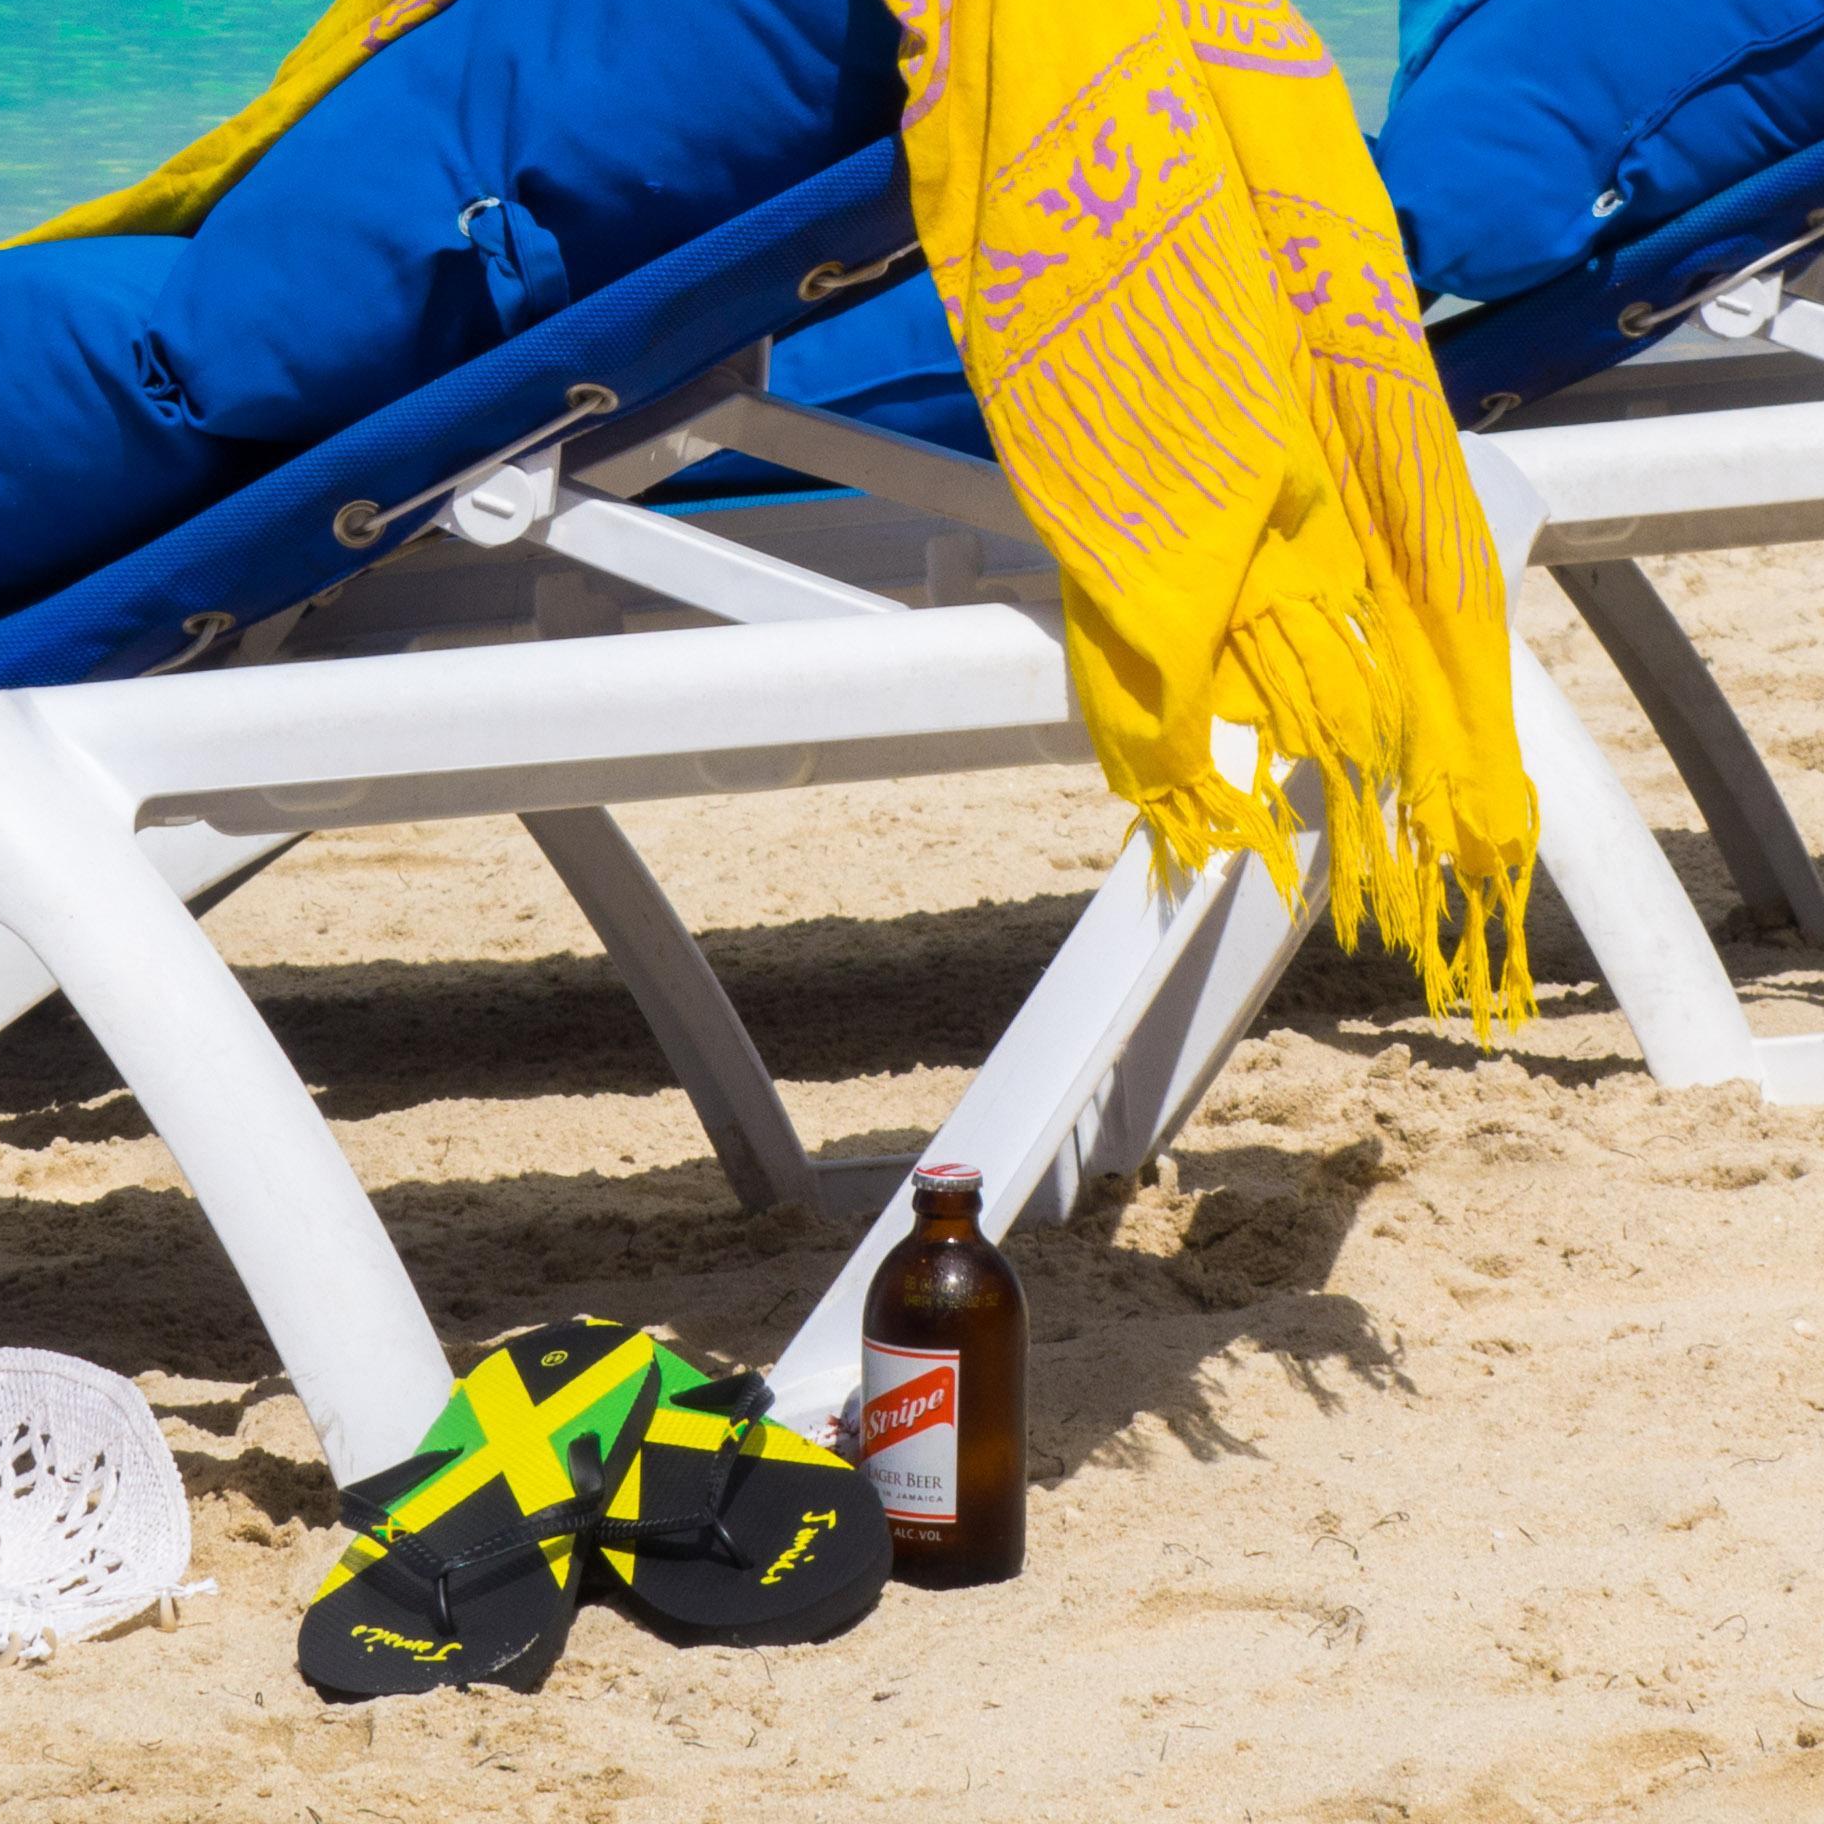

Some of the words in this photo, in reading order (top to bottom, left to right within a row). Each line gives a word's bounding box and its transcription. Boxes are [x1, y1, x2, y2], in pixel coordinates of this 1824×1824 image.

[866, 1388, 945, 1440] Stripe
[907, 1472, 943, 1489] BEER
[896, 1493, 943, 1502] JAMAICA
